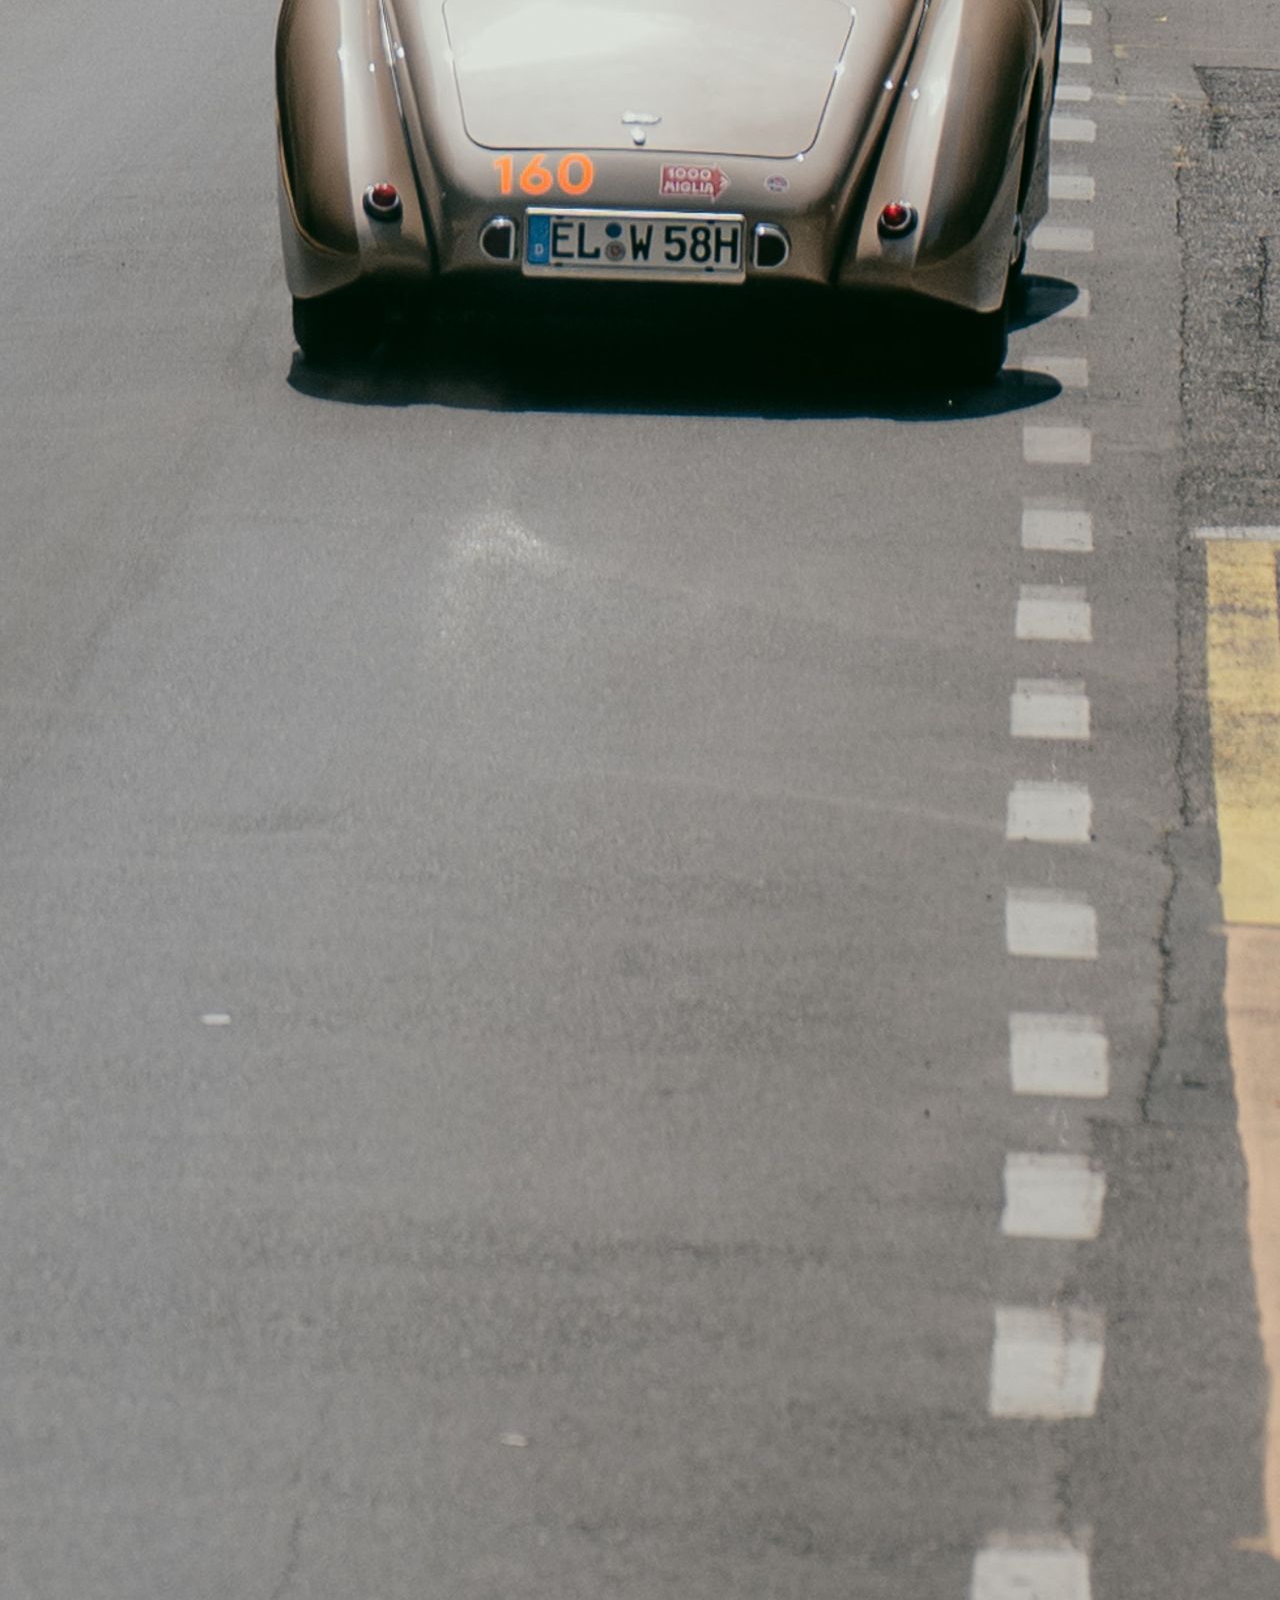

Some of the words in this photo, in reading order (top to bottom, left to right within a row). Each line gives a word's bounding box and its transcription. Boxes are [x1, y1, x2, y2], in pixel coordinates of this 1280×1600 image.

[494, 153, 595, 196] 160
[663, 181, 714, 194] MIGLIA
[667, 167, 712, 181] 1000
[551, 221, 601, 259] EL
[629, 224, 654, 262] W
[664, 226, 740, 264] 58H
